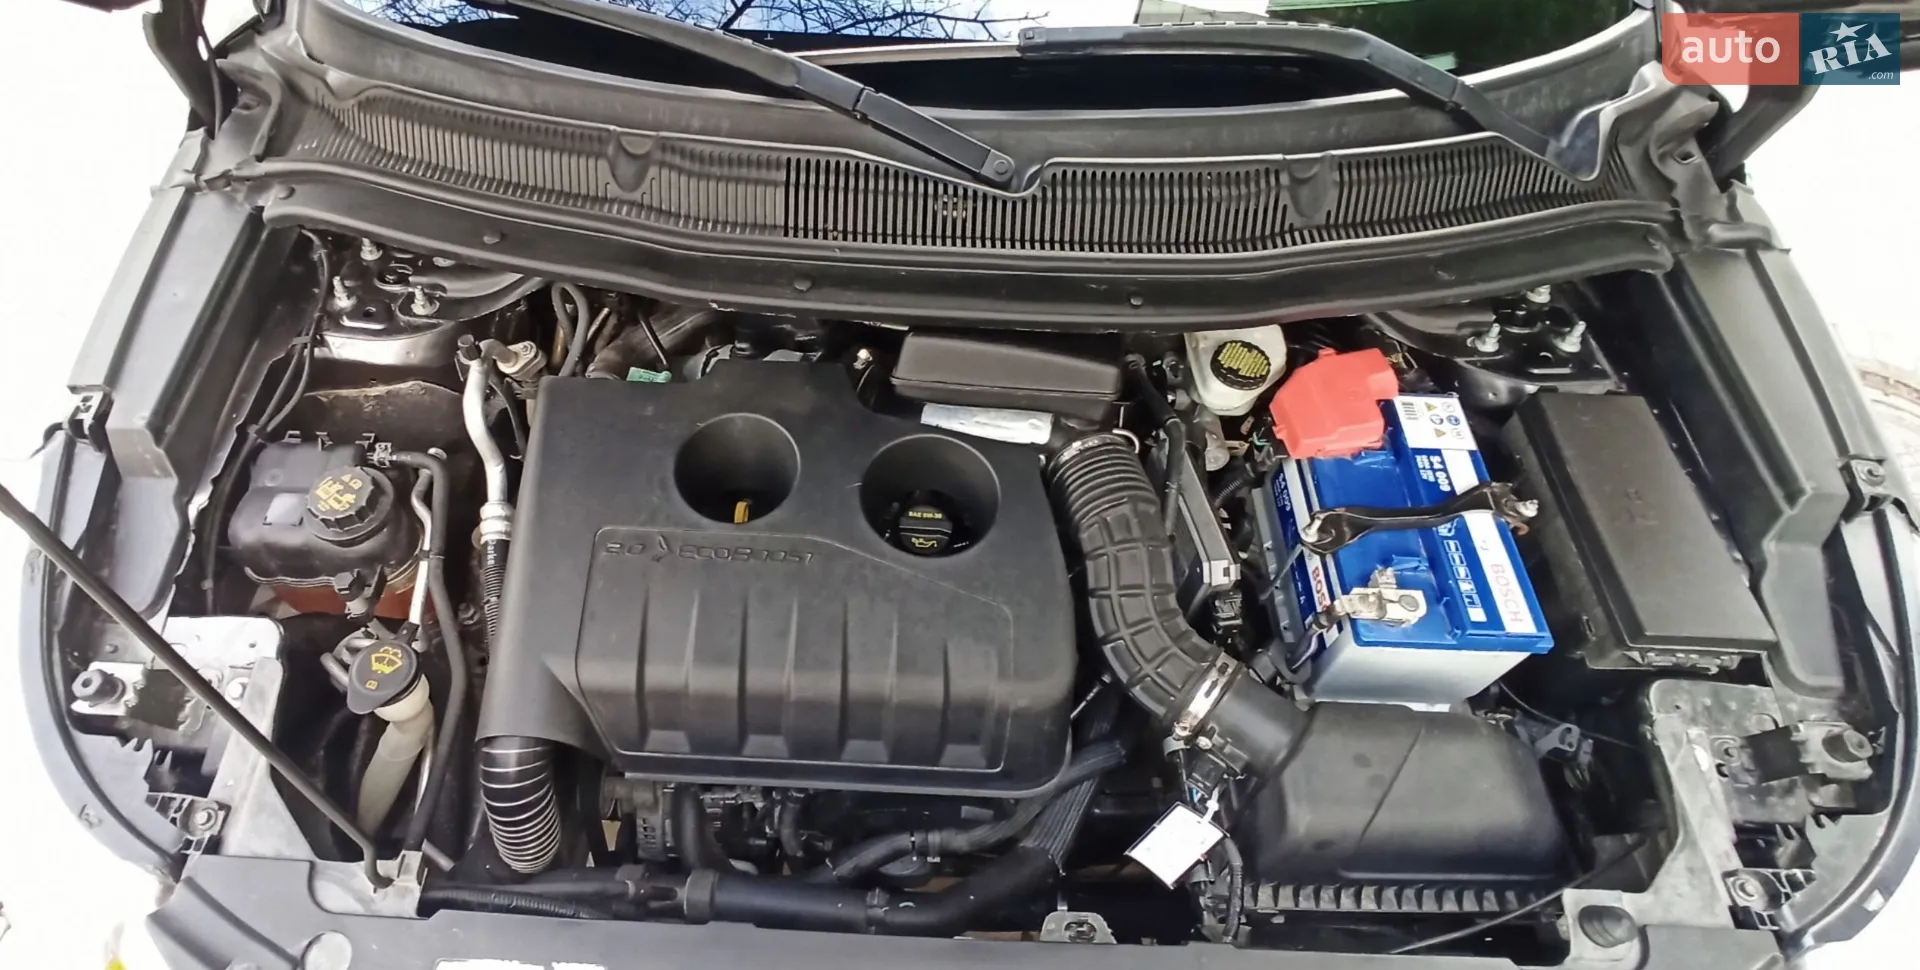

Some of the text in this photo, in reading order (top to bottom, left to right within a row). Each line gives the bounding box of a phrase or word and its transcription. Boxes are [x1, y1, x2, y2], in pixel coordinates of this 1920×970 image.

[1429, 455, 1452, 492] S4 009
[1490, 564, 1524, 622] BOSCH
